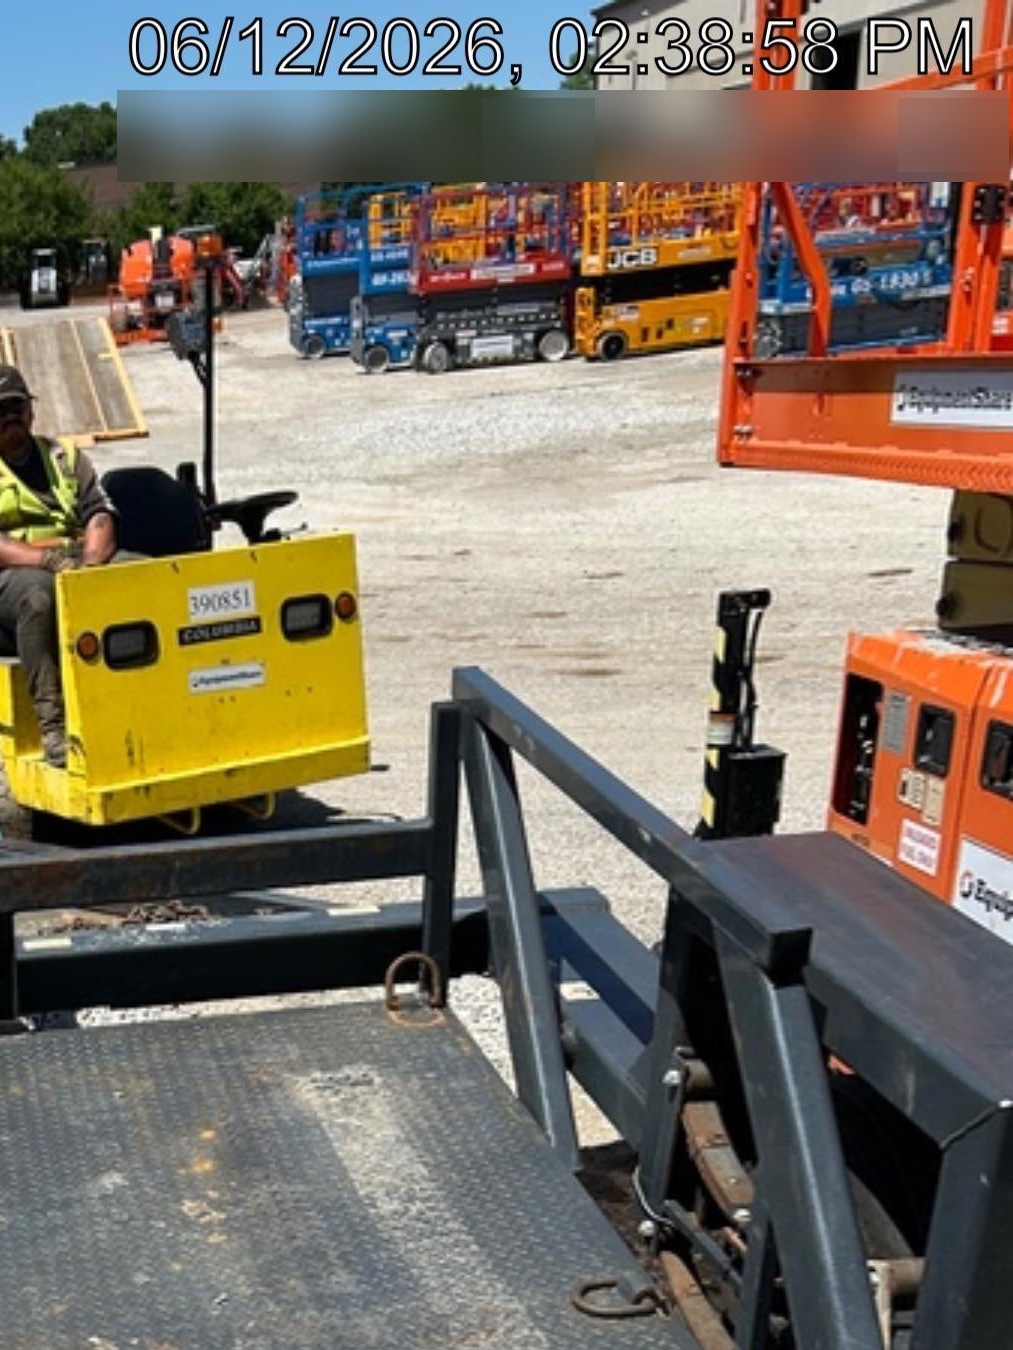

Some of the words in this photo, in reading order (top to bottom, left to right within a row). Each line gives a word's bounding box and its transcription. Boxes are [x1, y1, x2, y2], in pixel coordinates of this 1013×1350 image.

[608, 248, 657, 271] JCB
[189, 588, 251, 615] 390851
[182, 620, 258, 643] COLUMBIA
